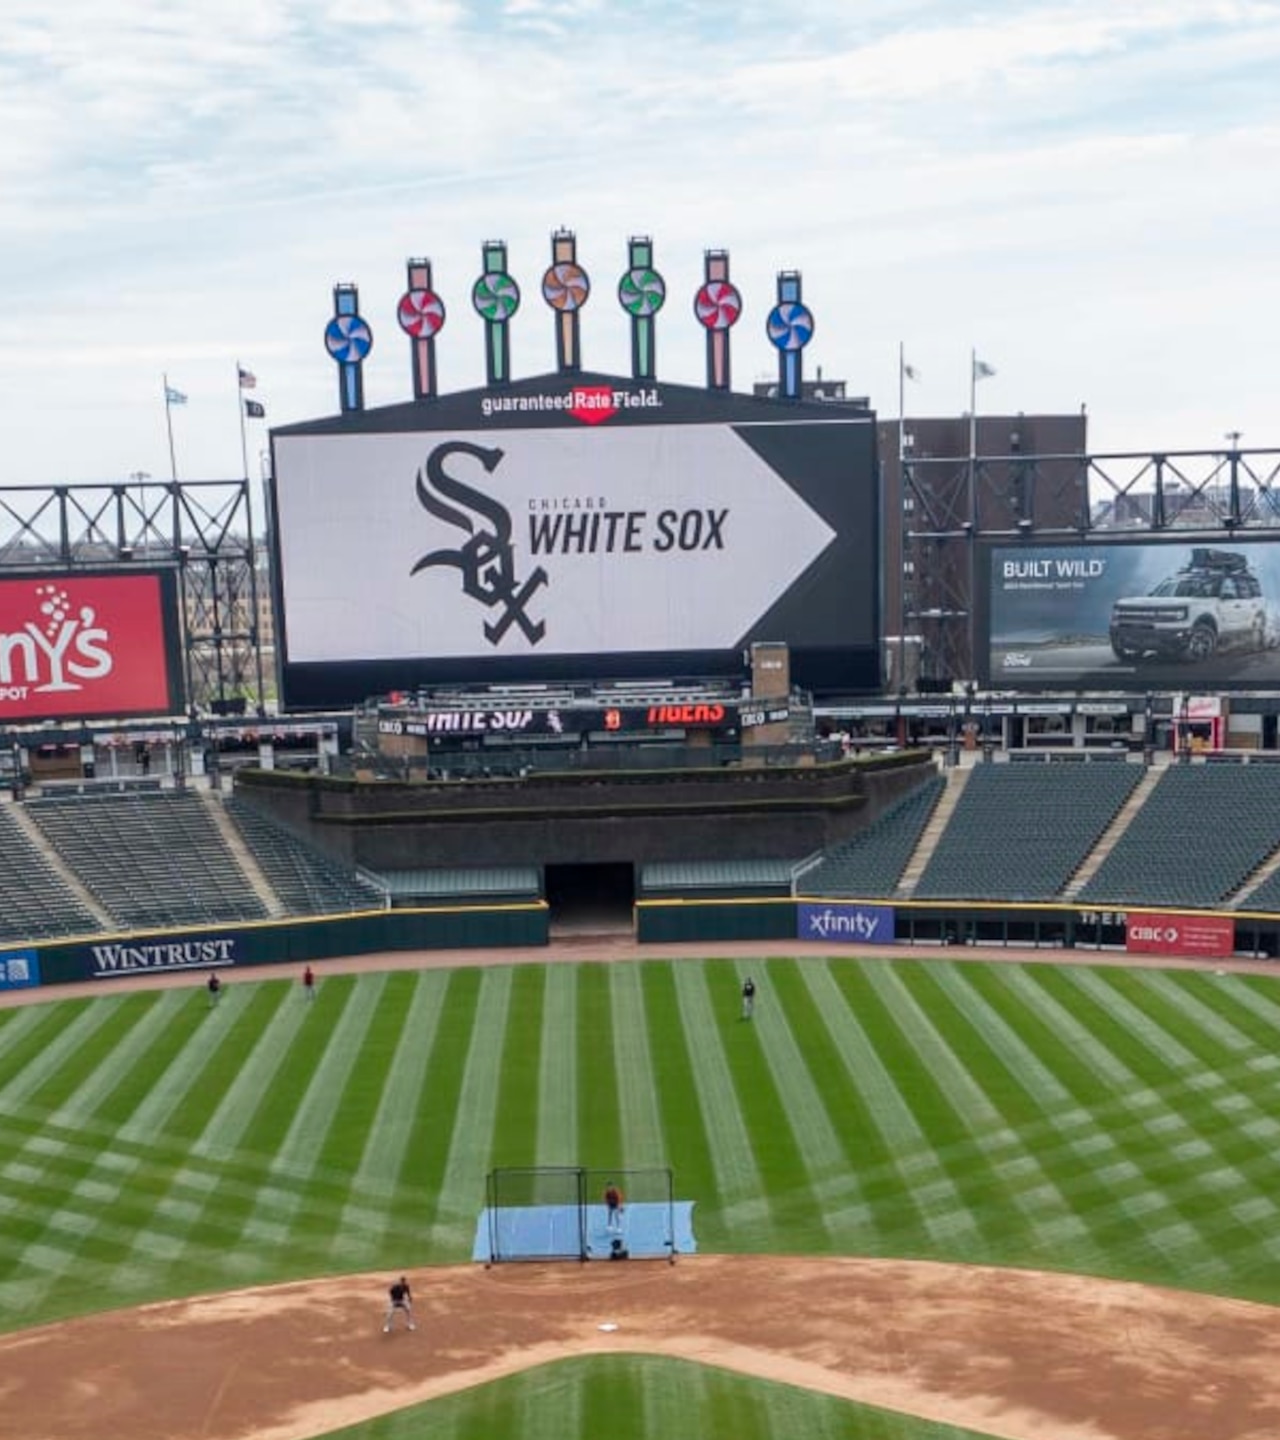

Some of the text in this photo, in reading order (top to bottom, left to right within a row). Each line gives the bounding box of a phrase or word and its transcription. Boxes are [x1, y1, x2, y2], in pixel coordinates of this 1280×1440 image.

[528, 496, 609, 511] CHICAGO
[528, 507, 730, 556] WHITE SOX
[1003, 560, 1051, 578] BUILT
[809, 908, 879, 938] xfinity
[1129, 925, 1163, 942] CIBC
[91, 939, 235, 971] WINTRUST
